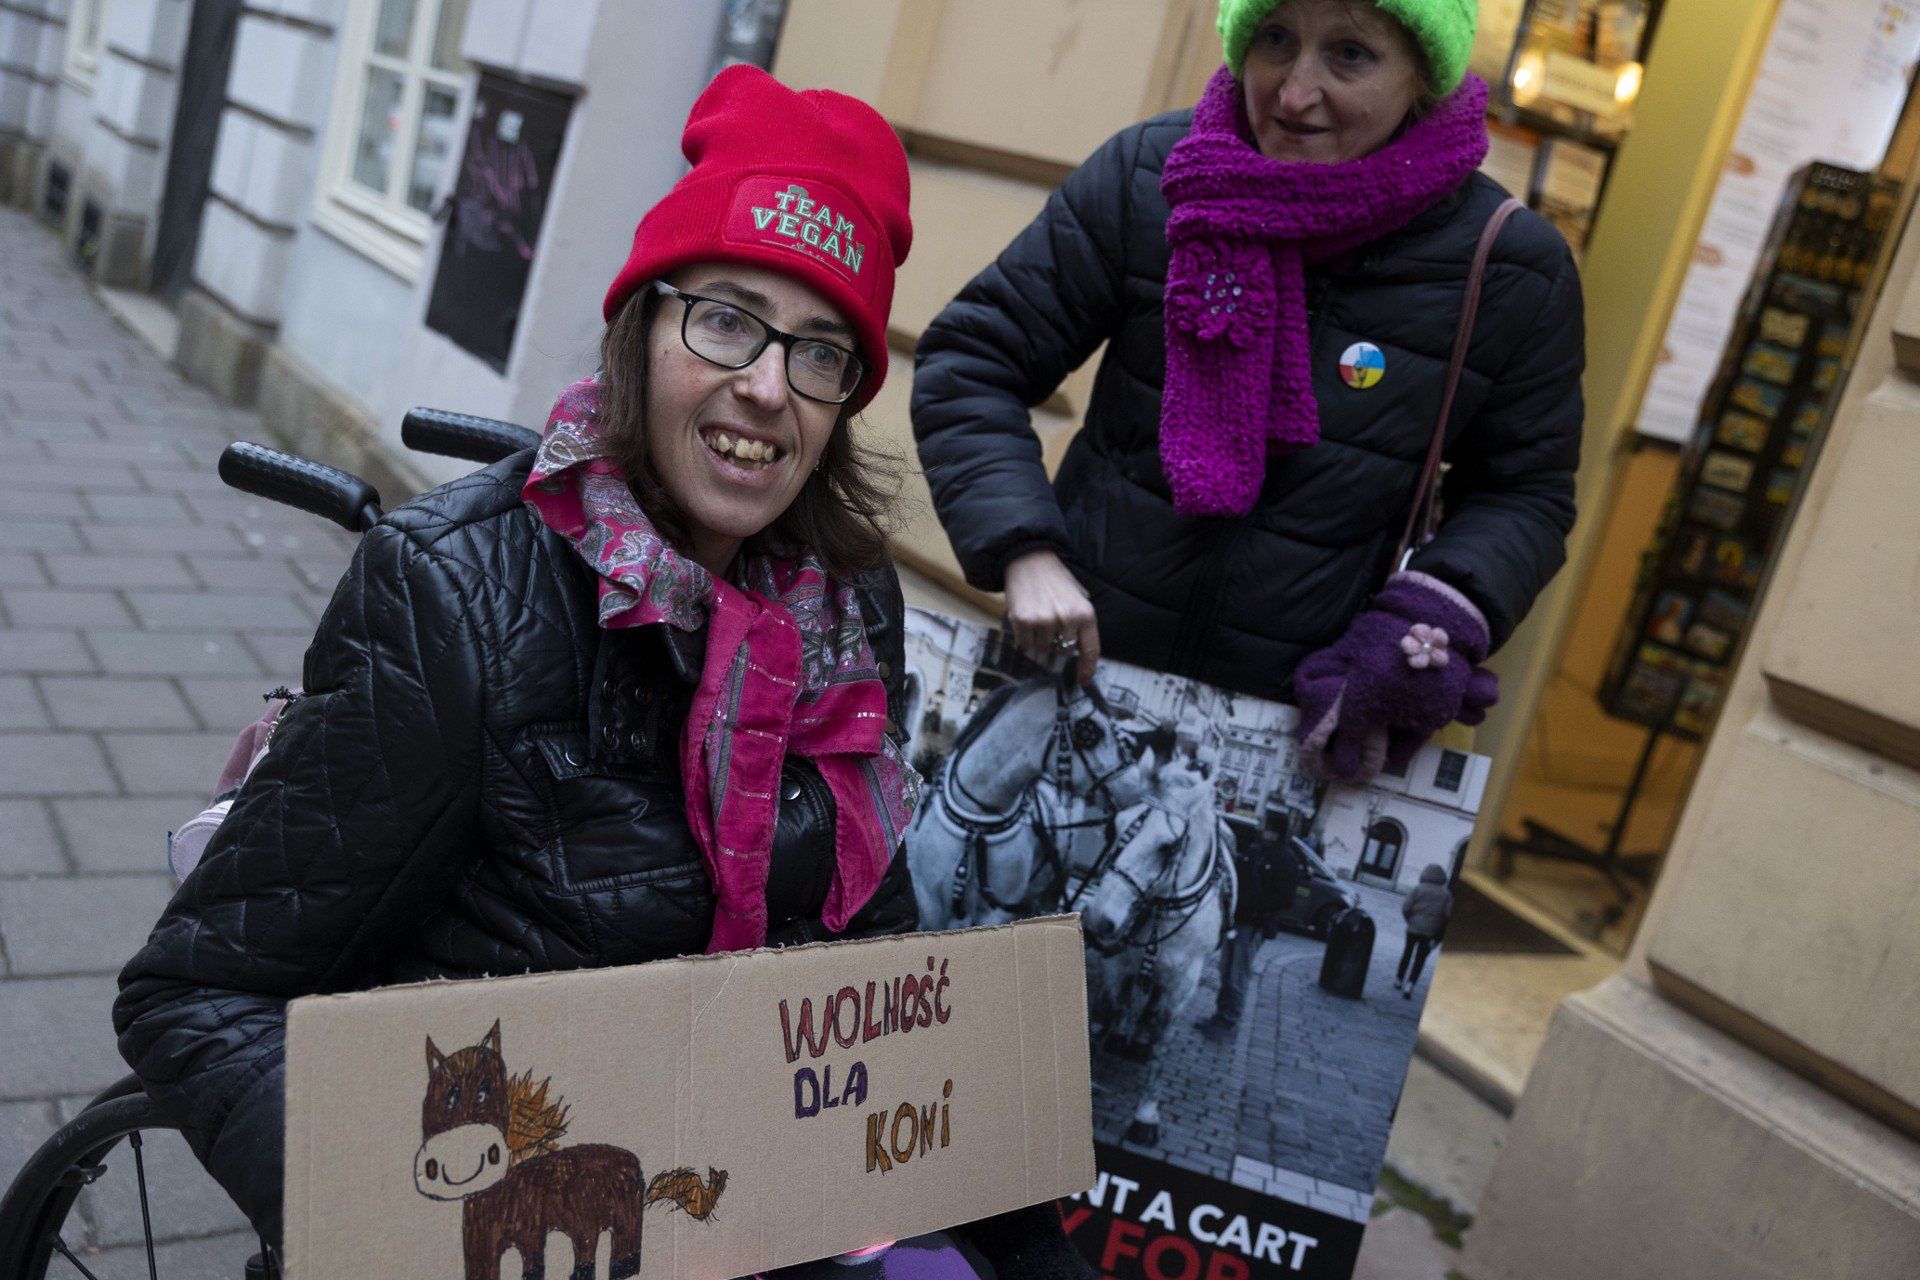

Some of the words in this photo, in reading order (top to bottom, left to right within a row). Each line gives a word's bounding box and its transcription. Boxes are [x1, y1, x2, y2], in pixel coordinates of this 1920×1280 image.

[751, 206, 864, 275] VEGAN
[775, 190, 855, 241] TEAM
[779, 956, 952, 1063] WOLNOŚĆ
[794, 1061, 869, 1119] DLA
[1138, 1190, 1176, 1231] A
[1188, 1204, 1319, 1271] CART
